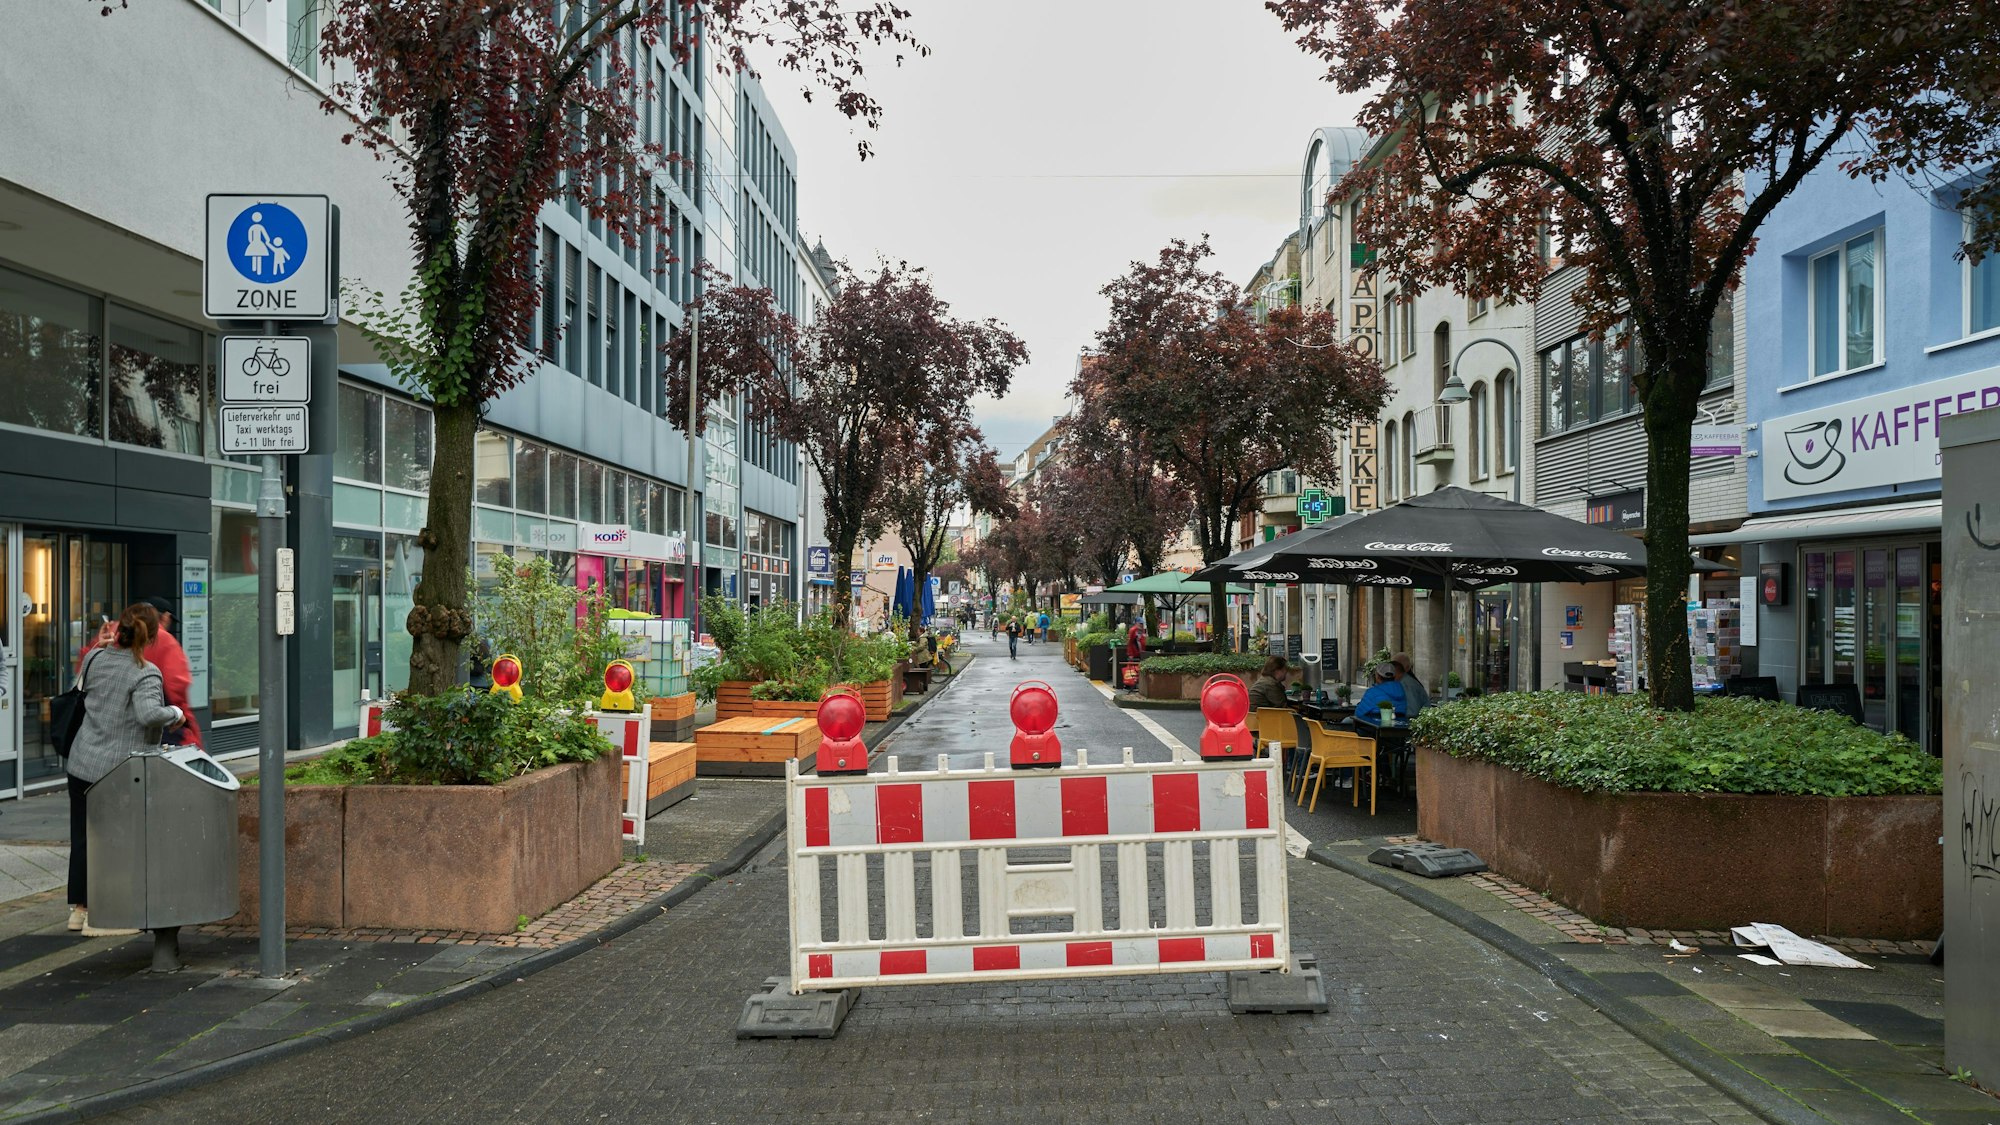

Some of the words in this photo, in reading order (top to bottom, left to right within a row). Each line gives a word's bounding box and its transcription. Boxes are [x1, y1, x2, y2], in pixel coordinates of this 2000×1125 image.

[236, 289, 297, 308] ZONE
[253, 380, 279, 394] frei
[1353, 275, 1374, 503] APOEKE
[228, 411, 281, 422] Lieferverkehr
[286, 411, 300, 421] und
[236, 425, 252, 434] Taxi
[256, 424, 293, 436] werktags
[235, 438, 240, 447] 6
[250, 438, 257, 447] 11
[262, 437, 276, 447] Uhr
[280, 437, 294, 447] frei
[1364, 541, 1453, 552] Coca-Cola
[878, 554, 893, 563] dm
[1542, 547, 1632, 560] Coca-Cola
[185, 583, 198, 593] LVR
